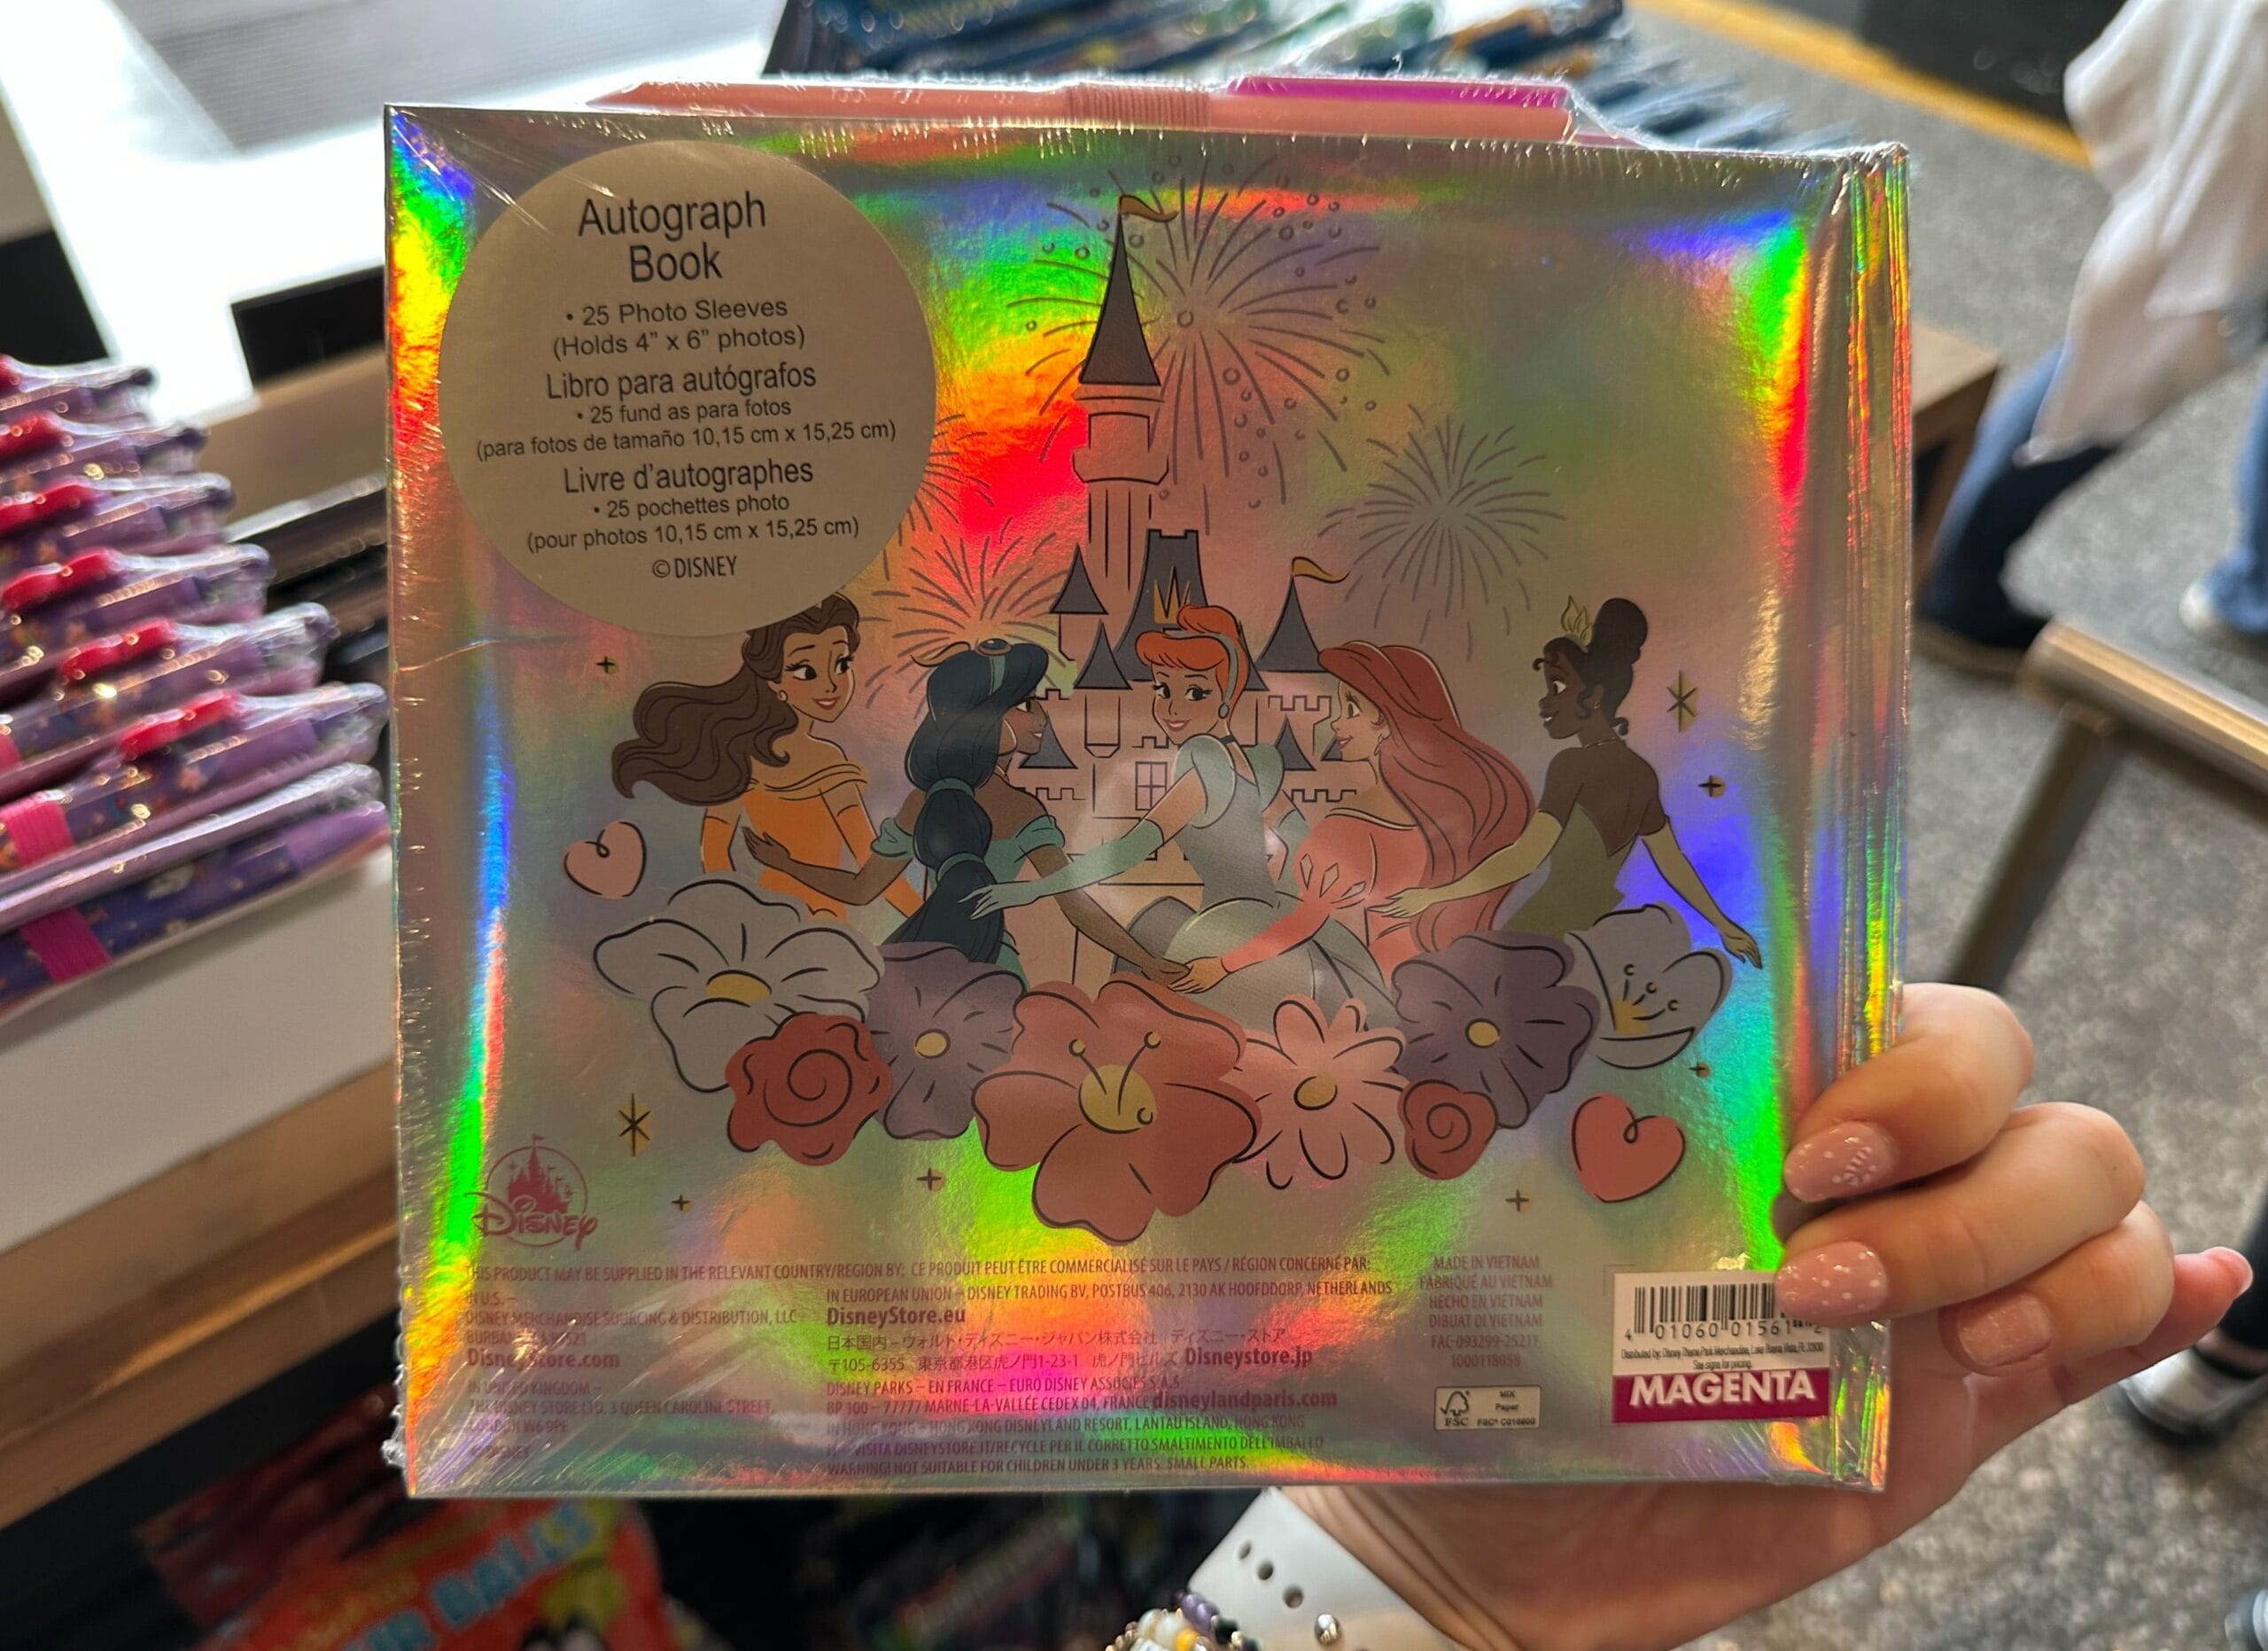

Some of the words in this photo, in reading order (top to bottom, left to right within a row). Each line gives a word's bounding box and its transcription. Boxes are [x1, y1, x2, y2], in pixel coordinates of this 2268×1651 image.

[578, 191, 766, 242] Autograph
[629, 241, 723, 283] Book
[582, 305, 610, 326] 25
[618, 303, 687, 323] Photo
[695, 300, 788, 320] Sleeves
[553, 335, 628, 362] (Holds
[665, 336, 680, 351] x
[718, 324, 804, 353] photos)
[546, 372, 610, 400] Libro
[618, 373, 674, 401] para
[682, 361, 817, 396] autógrafos
[590, 406, 613, 424] 25
[620, 403, 662, 423] fund
[668, 405, 690, 420] as
[696, 403, 740, 423] para
[744, 399, 792, 417] fotos
[477, 440, 525, 462] (para
[532, 436, 578, 454] fotos
[584, 433, 607, 451] de
[613, 430, 685, 449] tamaño
[693, 425, 744, 448] 10,15
[750, 428, 780, 444] cm
[785, 428, 796, 442] x
[803, 421, 855, 443] 15,25
[860, 419, 897, 442] cm)
[563, 466, 625, 494] Livre
[607, 500, 630, 518] 25
[637, 497, 730, 520] pochettes
[736, 494, 790, 516] photo
[527, 532, 578, 554] (pour
[583, 529, 648, 550] photos
[656, 524, 708, 545] 10,15
[713, 524, 742, 541] cm
[748, 525, 760, 539] x
[765, 518, 818, 540] 15,25
[824, 516, 859, 538] cm)
[495, 1266, 552, 1281] PRODUCT
[555, 1266, 583, 1281] MAY
[585, 1266, 600, 1281] BE
[603, 1266, 663, 1281] SUPPLIED
[665, 1266, 679, 1281] IN
[681, 1266, 705, 1280] THE
[709, 1265, 771, 1280] RELEVANT
[773, 1262, 882, 1280] COUNTRY/REGION
[912, 1261, 926, 1276] CE
[930, 1260, 981, 1276] PRODUIT
[985, 1260, 1014, 1275] PEUT
[1018, 1258, 1046, 1274] ÊTRE
[1050, 1257, 1146, 1273] COMMERCIALISÉ
[1150, 1257, 1173, 1273] SUR
[1176, 1258, 1189, 1273] LE
[1192, 1257, 1221, 1273] PAYS
[1232, 1254, 1277, 1272] RÉGION
[1279, 1254, 1341, 1272] CONCERNÉ
[1344, 1256, 1371, 1271] PAR:
[1433, 1256, 1467, 1269] MADE
[1472, 1256, 1483, 1269] IN
[1487, 1255, 1540, 1269] VIETNAM
[827, 1289, 839, 1303] IN
[843, 1288, 908, 1303] EUROPEAN
[912, 1286, 951, 1301] UNION
[967, 1285, 1012, 1300] DISNEY
[1014, 1284, 1067, 1299] TRADING
[1092, 1283, 1146, 1298] POSTBUS
[1178, 1282, 1207, 1297] 2130
[1209, 1282, 1225, 1297] AK
[1307, 1280, 1393, 1296] NETHERLANDS
[1481, 1275, 1497, 1289] AU
[1500, 1274, 1552, 1288] VIETNAM
[1429, 1295, 1469, 1309] HECHO
[1472, 1295, 1486, 1309] EN
[1489, 1294, 1542, 1308] VIETNAM
[466, 1312, 508, 1326] DISNEY
[668, 1312, 680, 1325] &
[681, 1310, 773, 1326] DISTRIBUTION,
[776, 1309, 797, 1323] LLC
[827, 1306, 966, 1329] DisneyStore.eu
[1429, 1313, 1471, 1328] DIBUAT
[1475, 1313, 1487, 1328] DI
[1488, 1312, 1542, 1328] VIETNAM
[1625, 1328, 1632, 1341] 4
[1655, 1322, 1718, 1340] 01060
[1184, 1346, 1314, 1368] Disneystore.jp
[532, 1381, 590, 1395] KINGDOM
[827, 1381, 870, 1398] DISNEY
[874, 1380, 913, 1396] PARKS
[928, 1380, 946, 1394] EN
[948, 1379, 994, 1394] FRANCE
[1010, 1378, 1042, 1393] EURO
[1045, 1376, 1087, 1392] DISNEY
[1629, 1370, 1815, 1406] MAGENTA
[827, 1399, 842, 1415] BP
[1041, 1396, 1078, 1411] CEDEX
[1104, 1395, 1149, 1409] FRANCE
[1153, 1389, 1338, 1413] disneylandparis.com
[1005, 1418, 1080, 1433] DISNEYLAND
[1050, 1439, 1072, 1454] PER
[1152, 1437, 1238, 1451] SMALTIMENTO
[895, 1460, 918, 1475] NOT
[921, 1460, 977, 1474] SUITABLE
[980, 1460, 1003, 1473] FOR
[1006, 1459, 1063, 1473] CHILDREN
[1069, 1458, 1108, 1472] UNDER
[1112, 1458, 1119, 1471] 3
[1166, 1456, 1205, 1470] SMALL
